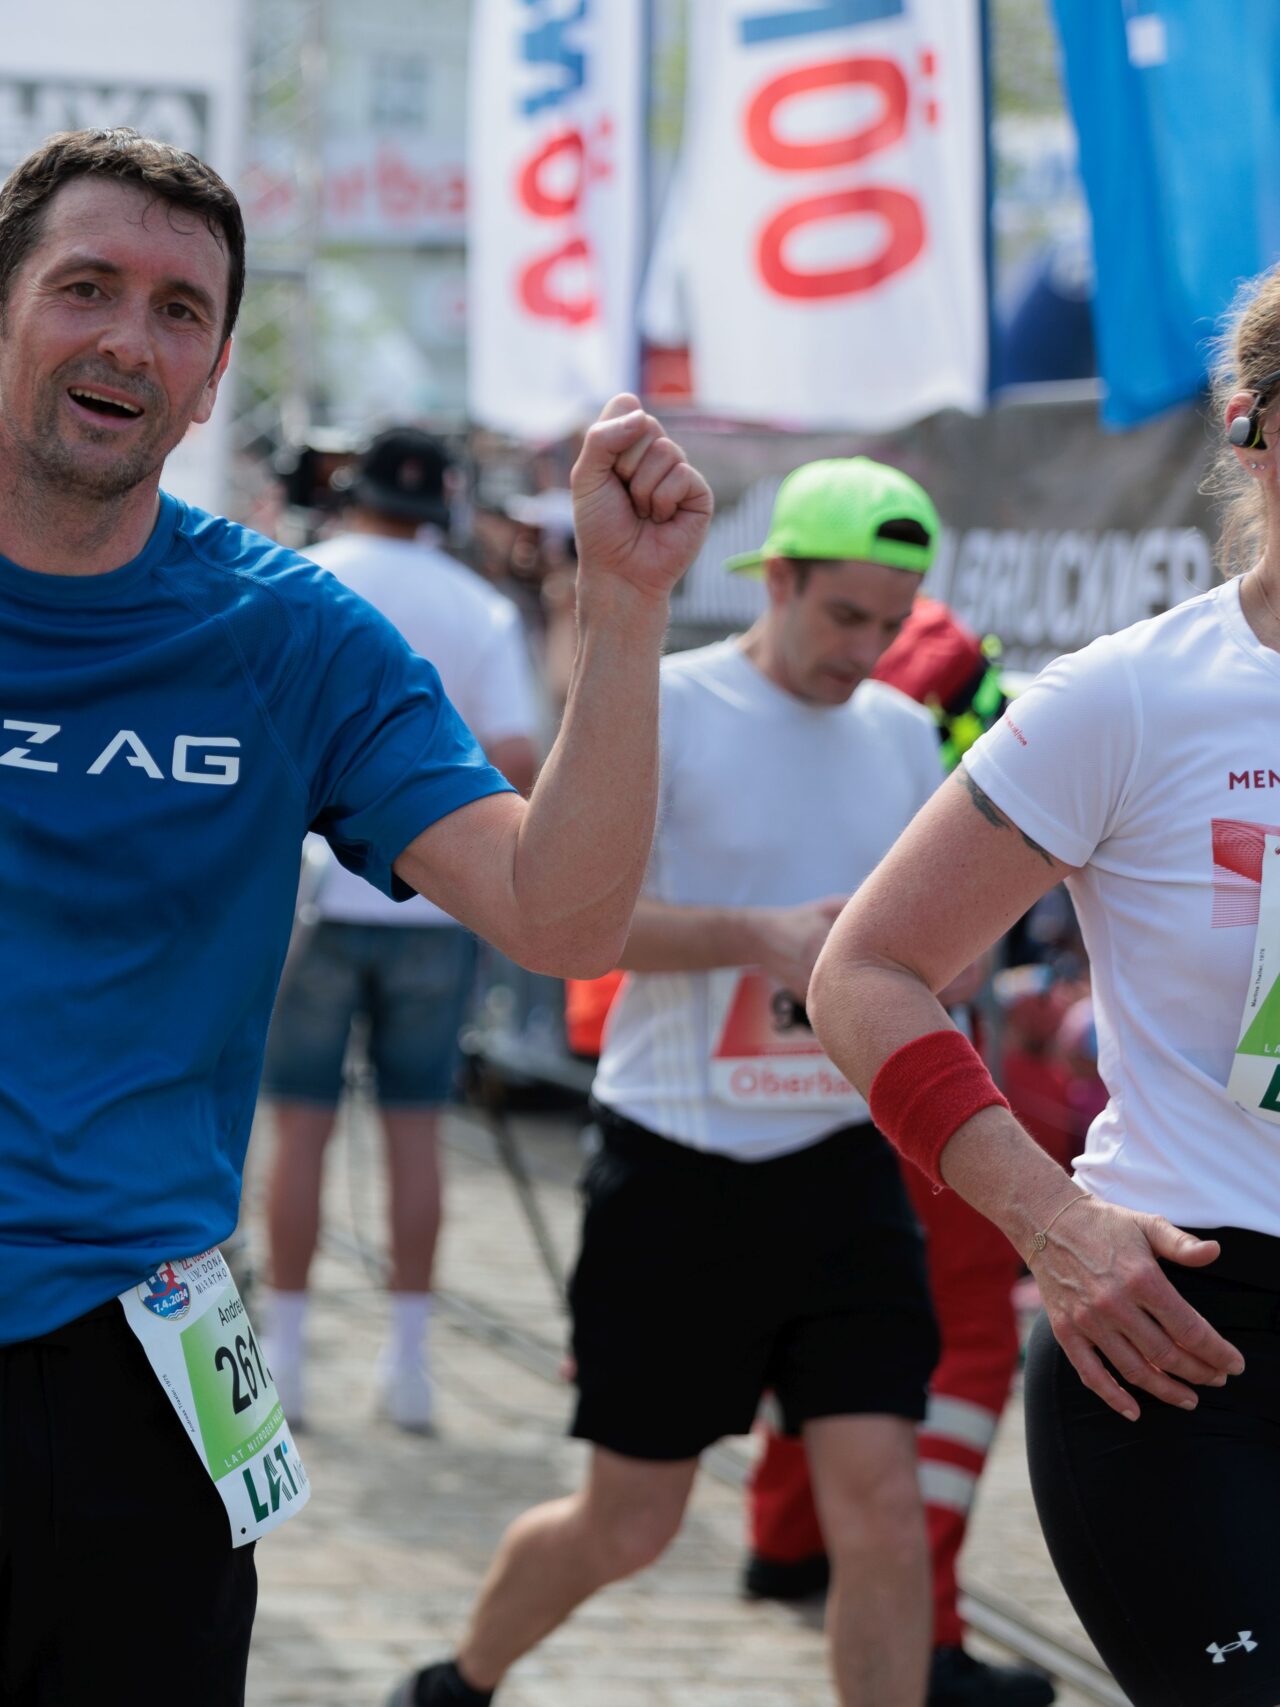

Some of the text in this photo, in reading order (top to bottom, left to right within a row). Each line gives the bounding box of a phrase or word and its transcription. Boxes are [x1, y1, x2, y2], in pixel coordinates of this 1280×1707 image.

[86, 729, 241, 785] AG
[152, 1289, 190, 1313] 7.4.2024
[214, 1326, 274, 1416] 261
[224, 1449, 245, 1469] LAT
[242, 1443, 299, 1524] LAT
